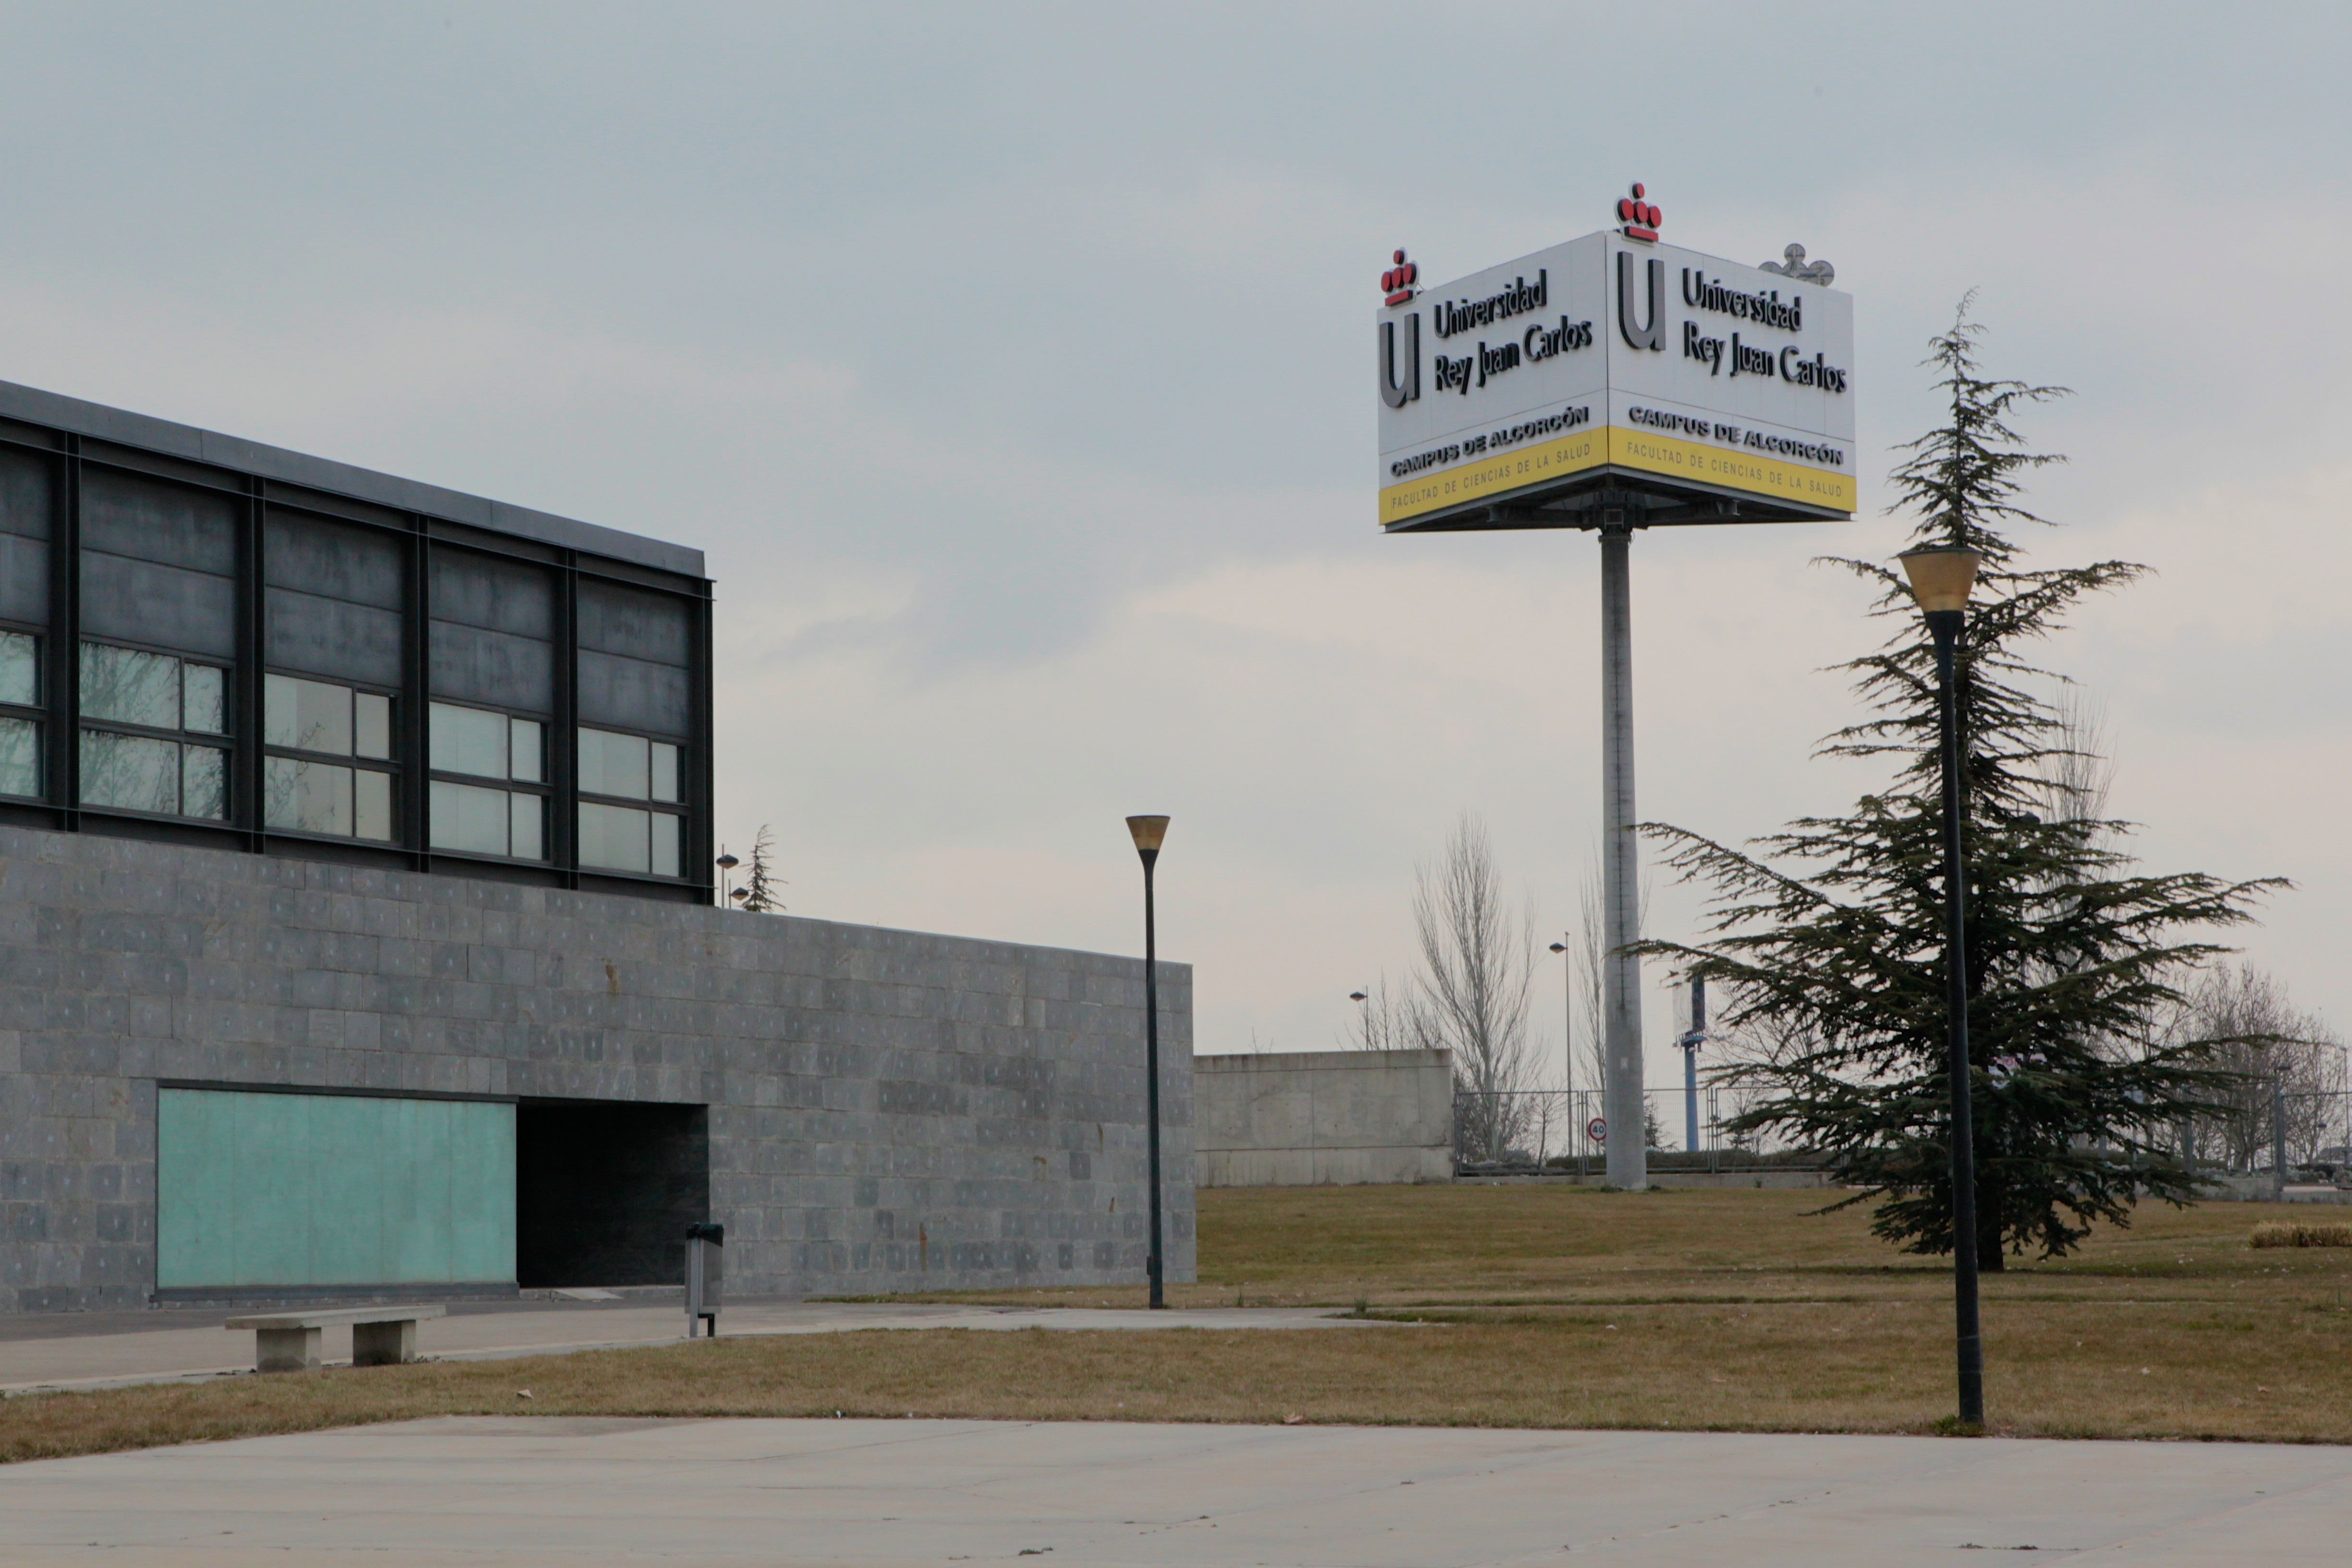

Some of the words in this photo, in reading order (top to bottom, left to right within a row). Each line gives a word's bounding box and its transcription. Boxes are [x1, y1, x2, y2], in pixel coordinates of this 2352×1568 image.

[1434, 269, 1547, 338] Universidad
[1682, 267, 1802, 331] Universidad
[1434, 355, 1473, 395] Rey
[1476, 342, 1519, 387] Juan
[1523, 315, 1592, 361] Carlos
[1684, 320, 1726, 376] Rey
[1730, 332, 1775, 377] Juan
[1780, 345, 1847, 392] Carlos
[1390, 444, 1459, 476] CAMPUS
[1463, 435, 1486, 455] DE
[1489, 406, 1589, 447] ALCORCÓN
[1629, 406, 1711, 436] CAMPUS
[1715, 423, 1741, 443] DE
[1744, 430, 1844, 465] ALCORCÓN
[1393, 486, 1438, 509] FACULTAD
[1445, 480, 1456, 494] DE
[1464, 466, 1510, 489] CIENCIAS
[1518, 460, 1529, 474] DE
[1537, 455, 1549, 469] LA
[1557, 444, 1590, 463] SALUD
[1628, 441, 1682, 464] FACULTAD
[1690, 454, 1703, 469] DE
[1711, 459, 1762, 480] CIENCIAS
[1770, 471, 1782, 485] DE
[1790, 476, 1801, 489] LA
[1810, 480, 1841, 497] SALUD
[1592, 1125, 1605, 1134] 40
